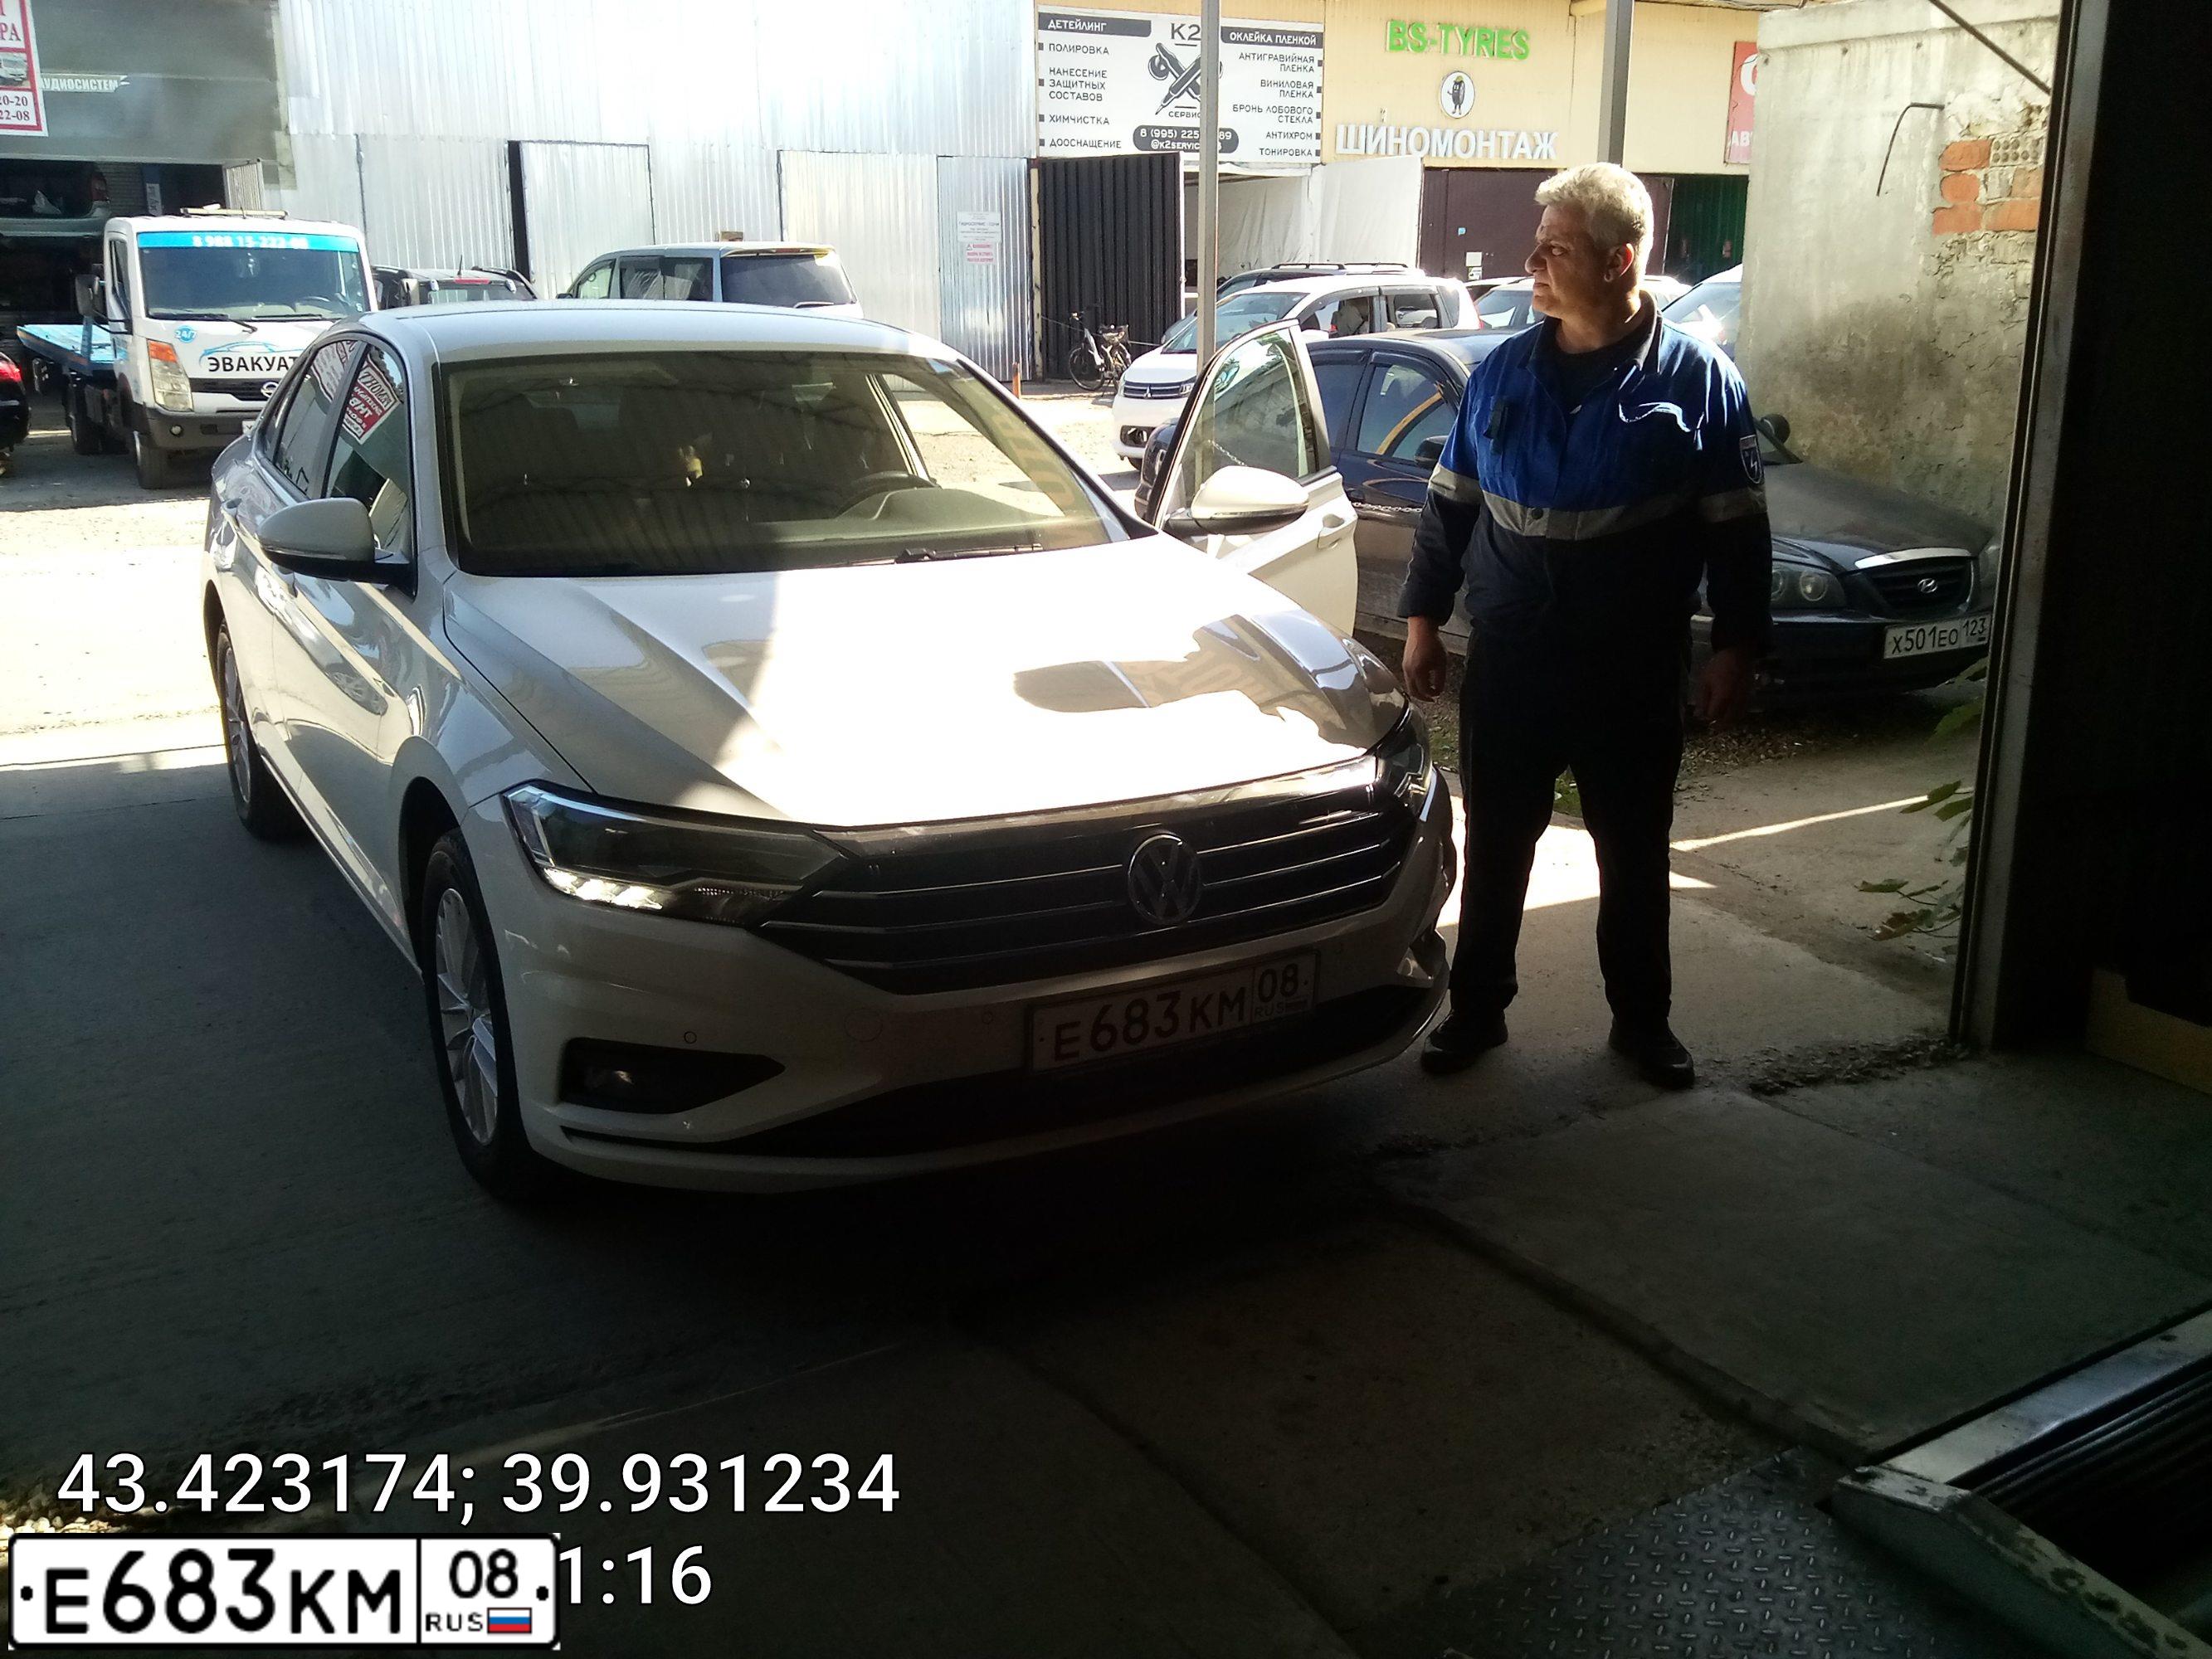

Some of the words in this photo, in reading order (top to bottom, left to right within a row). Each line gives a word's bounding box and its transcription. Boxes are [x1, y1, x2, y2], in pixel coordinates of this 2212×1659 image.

[1048, 18, 1107, 32] ДЕТЕЙЛИНГ
[1171, 23, 1201, 41] K2
[1230, 32, 1273, 43] ОКЛЕЙКА
[1275, 34, 1317, 46] ПЛЕНКОЙ
[1386, 19, 1530, 60] BS-TYRES
[1049, 43, 1109, 55] ПОЛИРОВКА
[1239, 52, 1315, 63] АНТИГРАВИЙНАЯ
[1049, 67, 1108, 79] НАНЕСЕНИЕ
[1280, 64, 1314, 73] ПЛЕНКА
[1049, 79, 1105, 90] ЗАЩИТНЫХ
[1260, 79, 1313, 89] ВИНИЛОВАЯ
[1049, 90, 1103, 101] СОСТАВОВ
[1279, 90, 1313, 98] ПЛЕНКА
[0, 95, 28, 106] 0-20
[1233, 105, 1263, 113] БРОНЬ
[1266, 106, 1313, 114] ЛОБОВОГО
[1049, 114, 1109, 124] ХИМЧИСТКА
[1278, 115, 1313, 124] СТЕКЛА
[1140, 129, 1147, 138] 8
[1151, 129, 1177, 139] (995)
[1266, 132, 1313, 140] АНТИХРОМ
[1731, 131, 1752, 146] АВ
[1050, 139, 1121, 148] ДООСНАЩЕНИЕ
[1336, 124, 1558, 160] ШИНОМОНТАЖ
[1259, 148, 1312, 157] ТОНИРОВКА
[175, 331, 196, 339] 24/7
[1254, 1004, 1285, 1019] RUS
